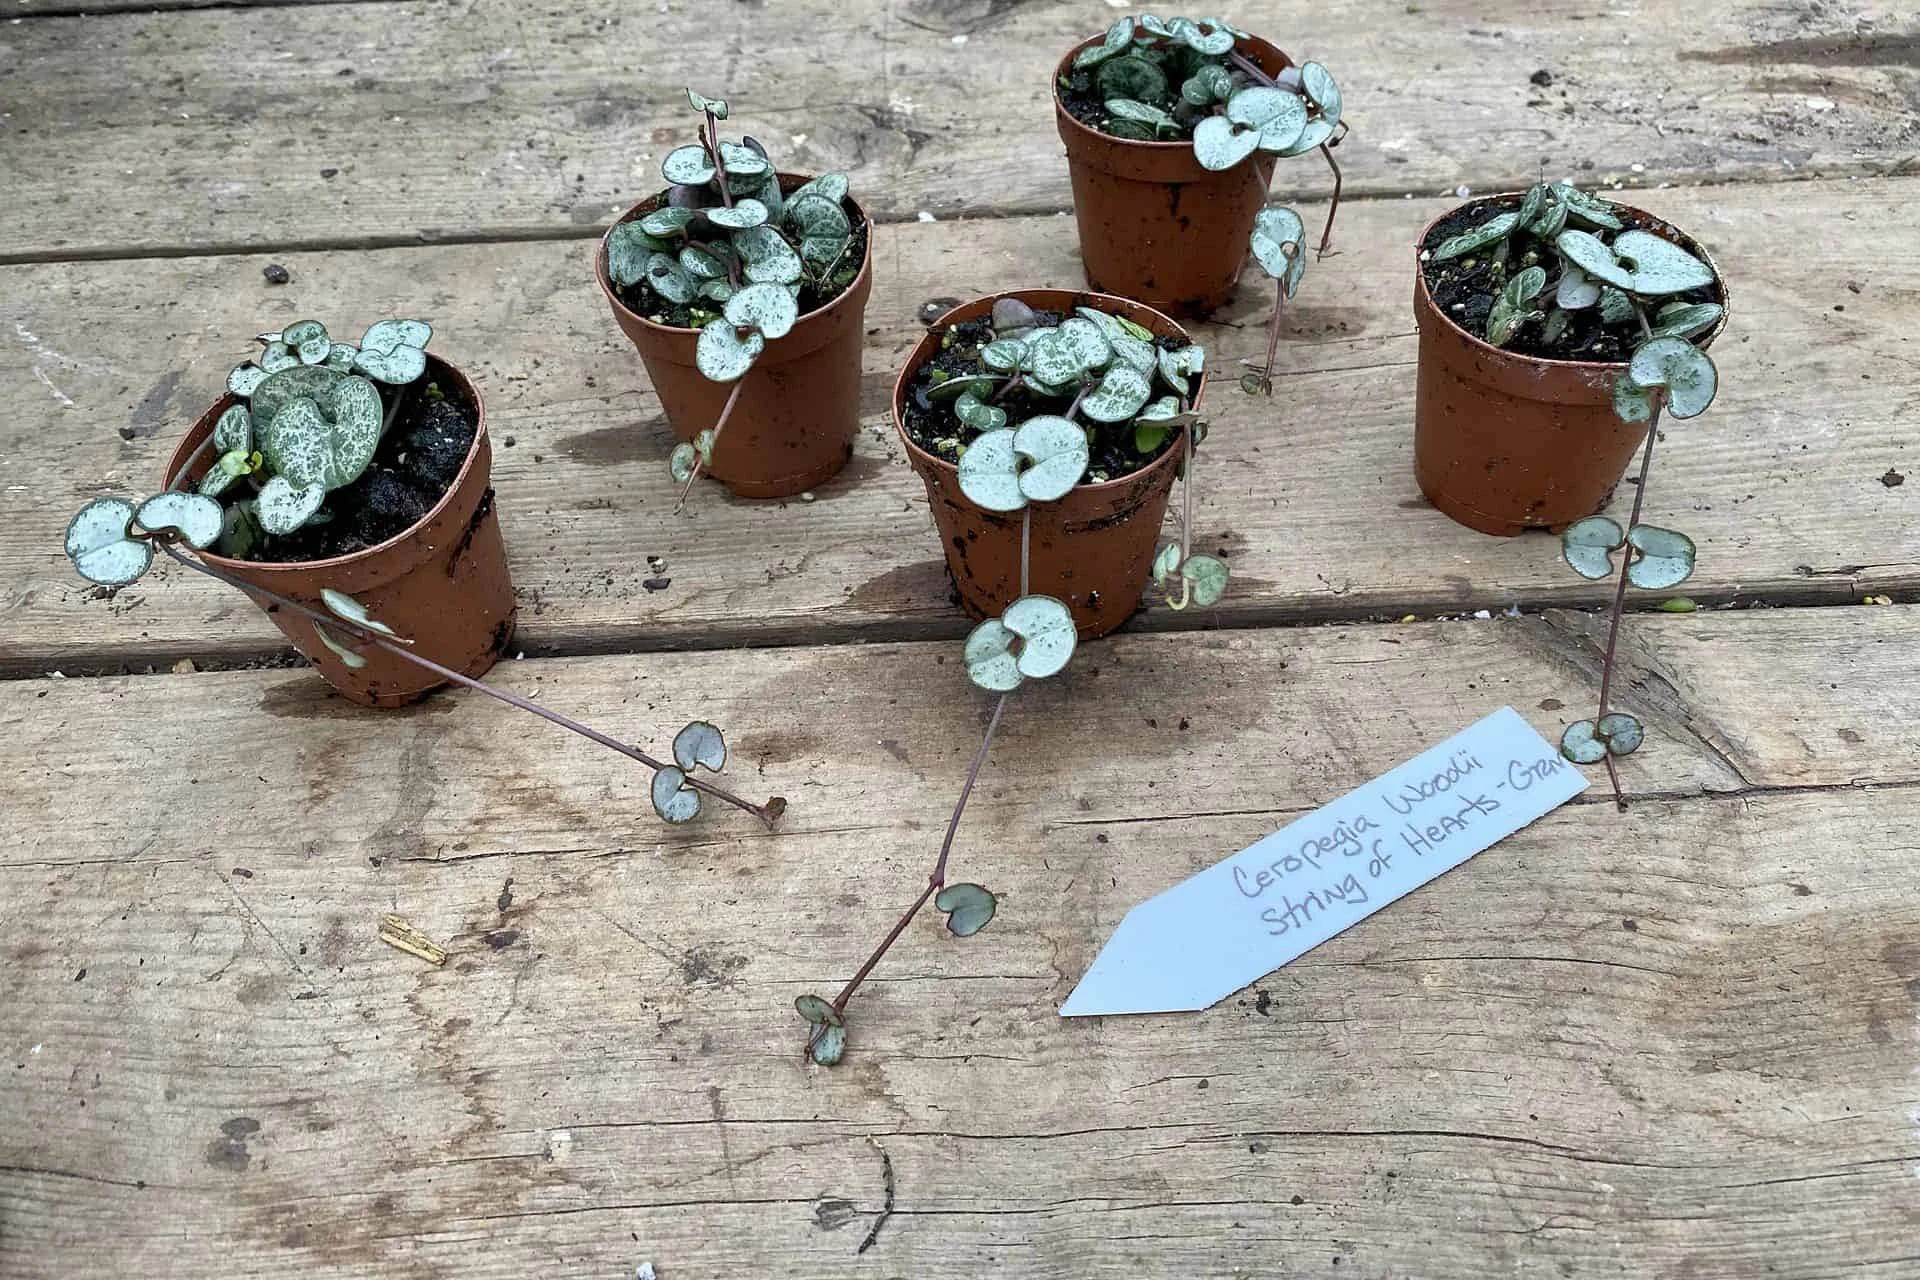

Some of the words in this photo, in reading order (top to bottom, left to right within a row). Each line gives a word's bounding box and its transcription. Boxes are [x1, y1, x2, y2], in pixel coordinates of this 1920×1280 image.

[1233, 815, 1380, 898] Ceropegia
[1382, 749, 1483, 814] Woodii
[1369, 838, 1392, 878] of
